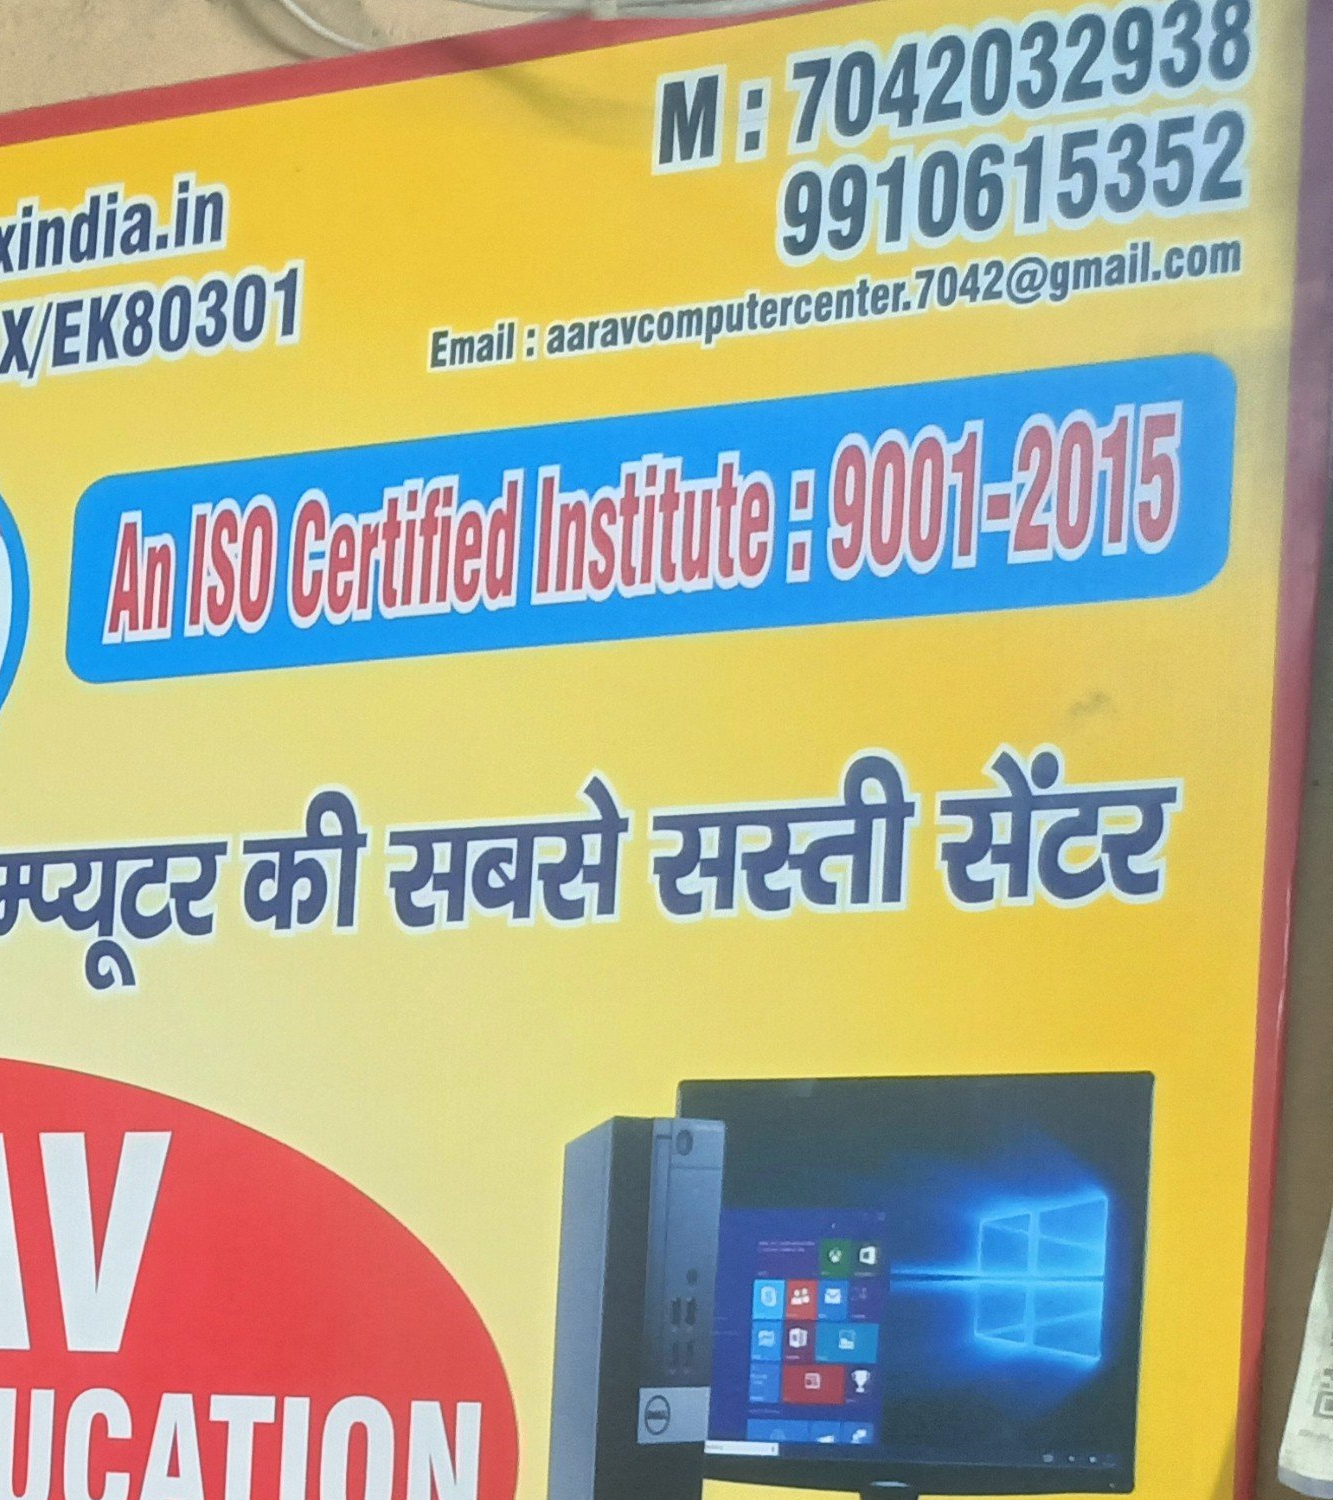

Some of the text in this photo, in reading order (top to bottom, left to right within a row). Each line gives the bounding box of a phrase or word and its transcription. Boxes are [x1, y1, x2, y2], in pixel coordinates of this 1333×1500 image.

[658, 74, 719, 165] M
[791, 0, 1252, 145] 7042032938
[782, 120, 1246, 256] 9910615352
[429, 328, 515, 369] Email
[545, 238, 1242, 353] aaravcomputercenter.7042@gmail.com
[106, 514, 171, 637] An
[188, 507, 271, 628] ISO
[293, 481, 514, 621] Certified
[538, 456, 772, 598] Institute
[831, 414, 1179, 571] 9001-2015
[244, 791, 368, 931] की
[389, 777, 629, 926] सबसे
[654, 756, 917, 915] सस्ती
[940, 749, 1177, 905] सेंटर
